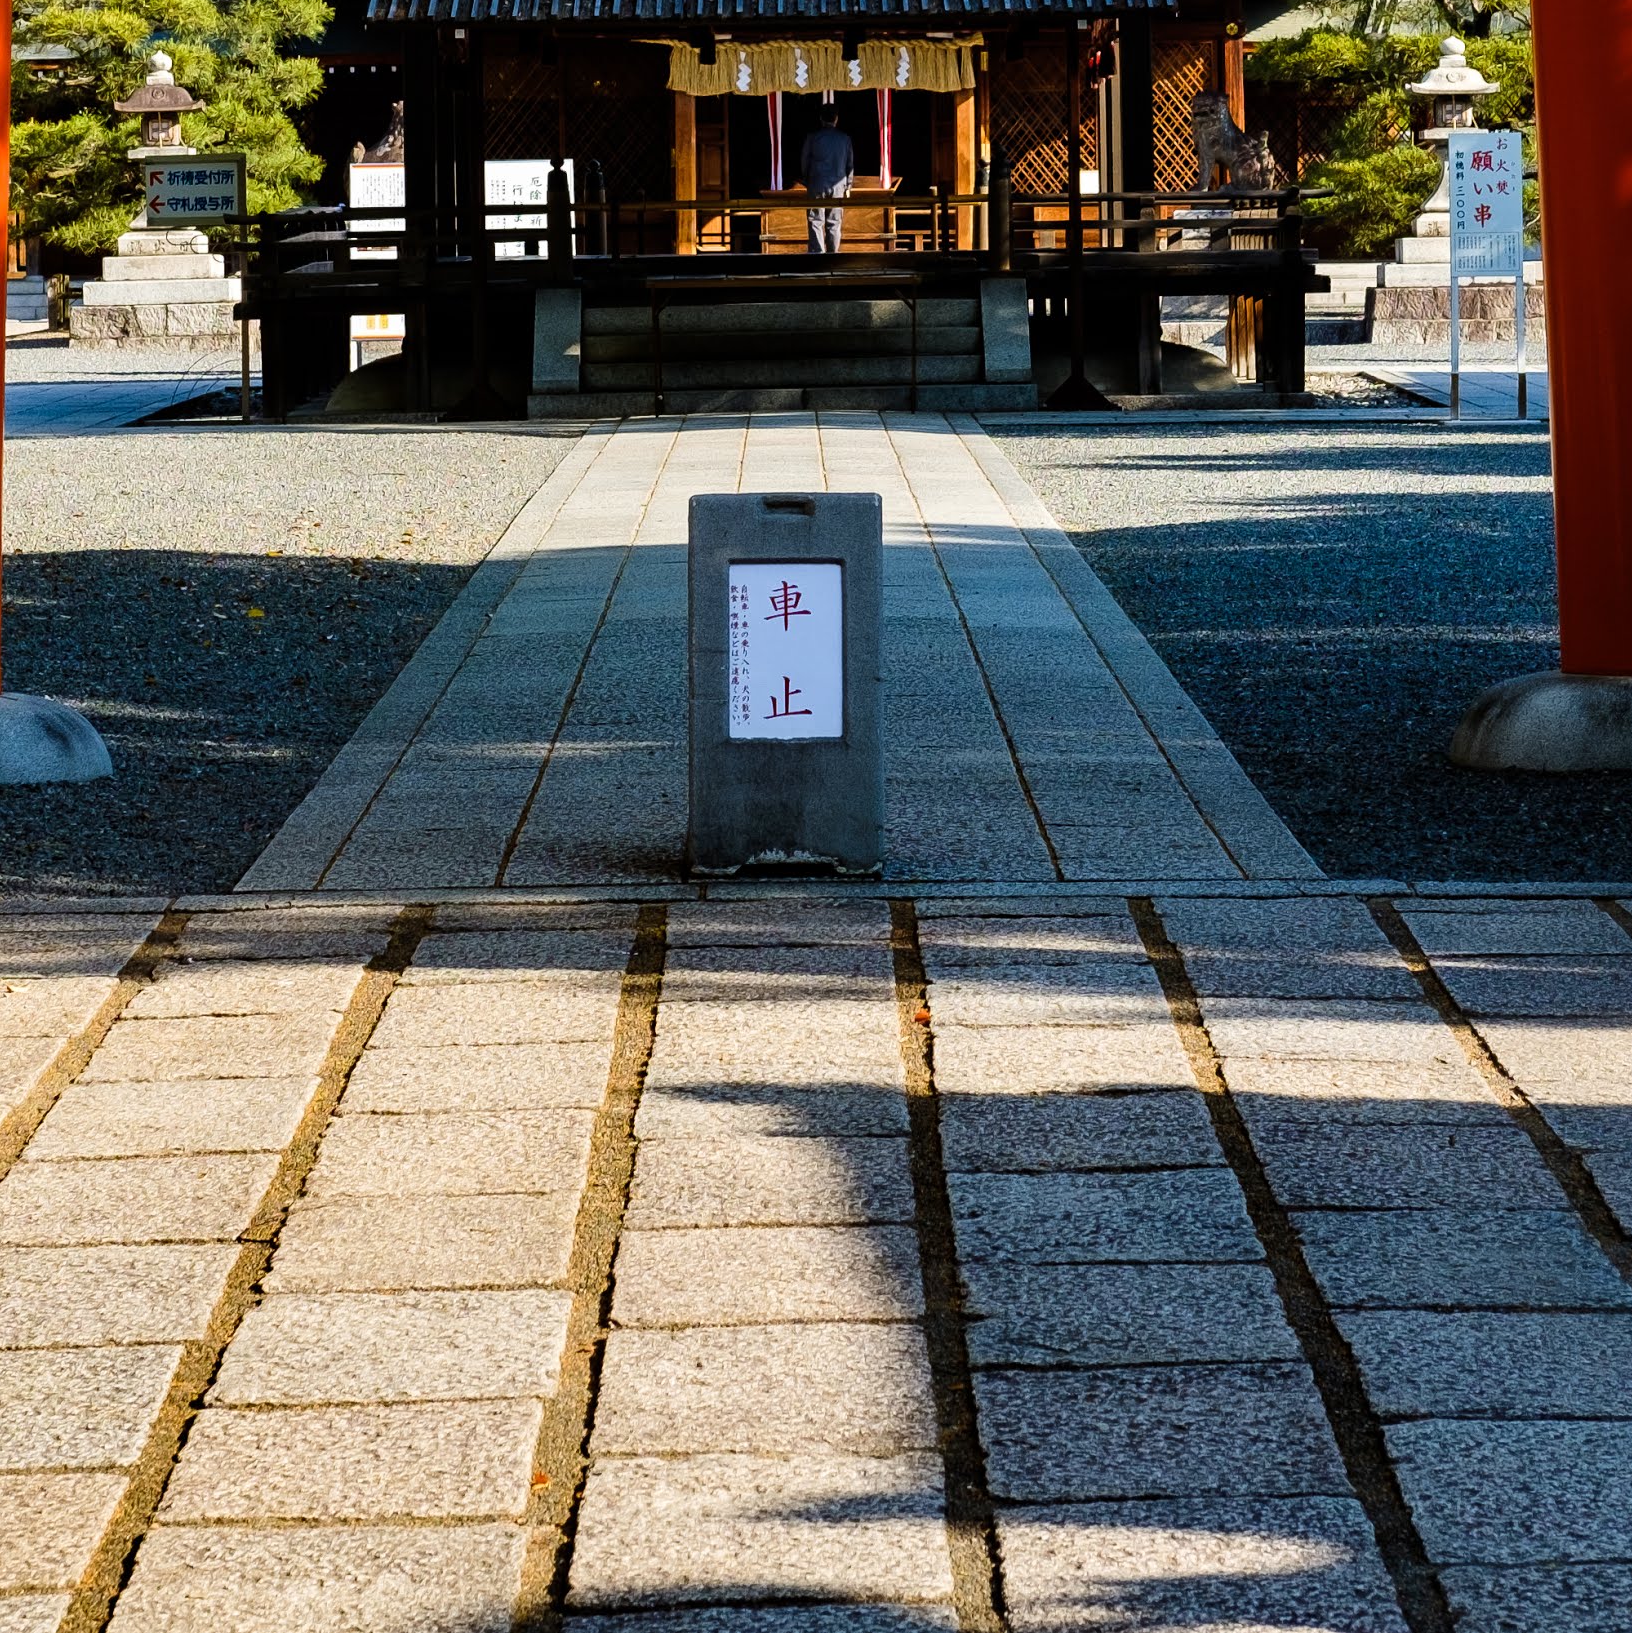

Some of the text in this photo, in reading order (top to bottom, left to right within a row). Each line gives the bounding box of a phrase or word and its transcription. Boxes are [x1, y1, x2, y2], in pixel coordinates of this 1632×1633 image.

[1470, 150, 1494, 229] 願い串
[1496, 137, 1510, 196] お火焚
[167, 196, 235, 213] 守札授与所
[763, 580, 813, 720] 車止
